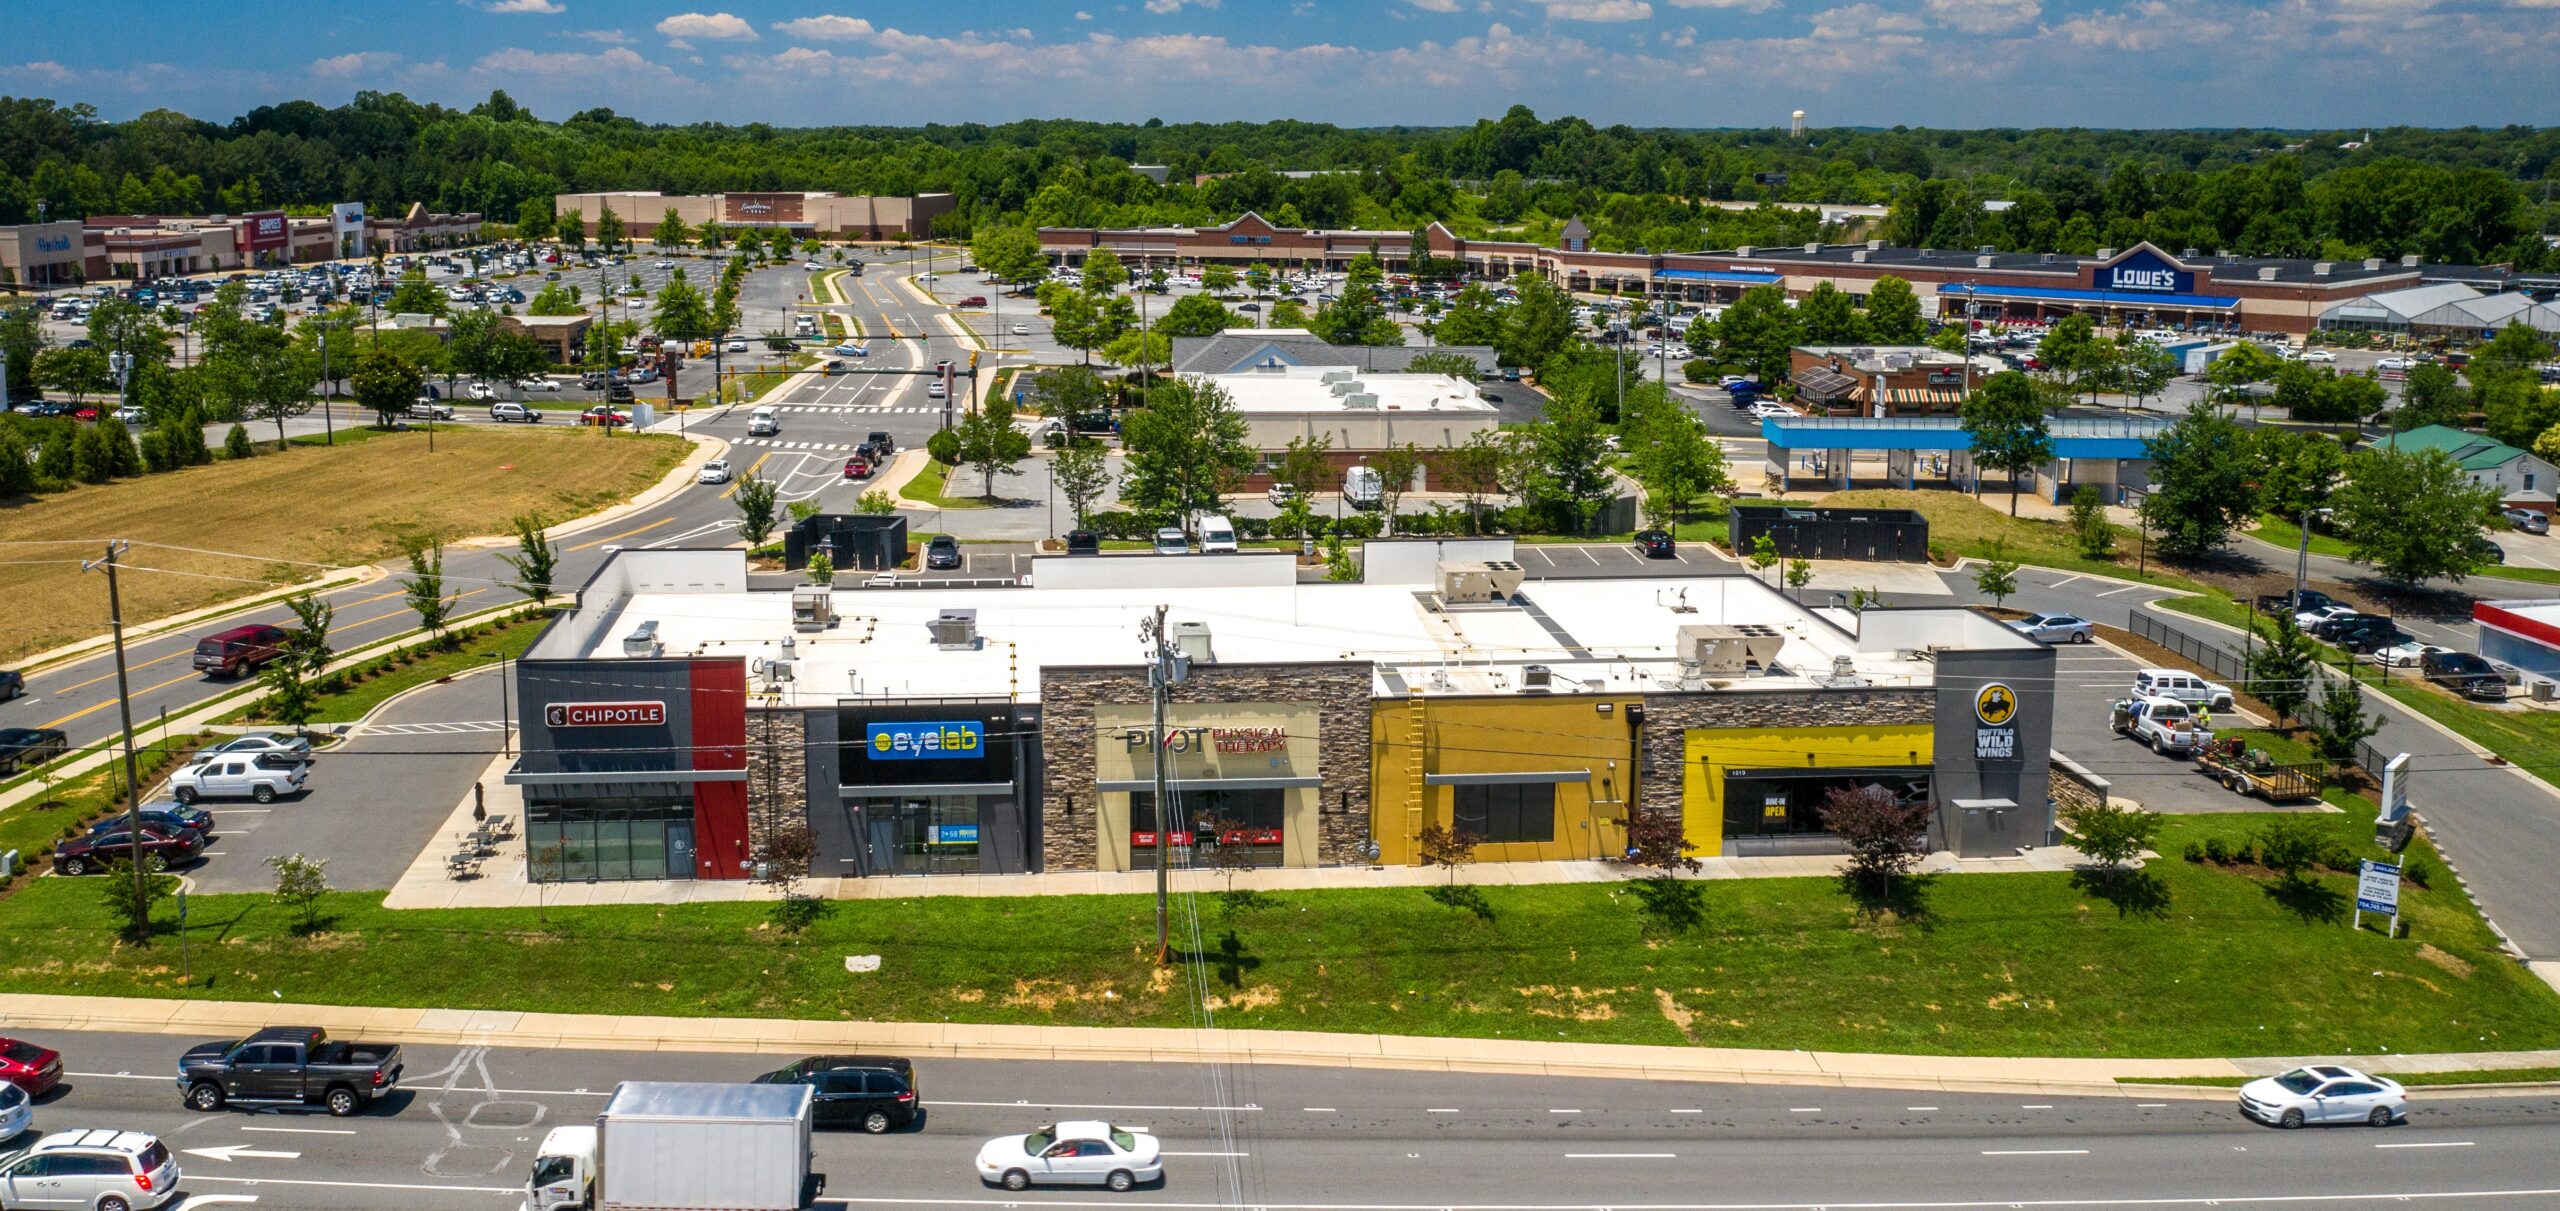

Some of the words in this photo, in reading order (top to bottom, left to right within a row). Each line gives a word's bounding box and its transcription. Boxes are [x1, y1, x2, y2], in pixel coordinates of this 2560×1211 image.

[2113, 267, 2175, 287] LOWE'S
[572, 709, 660, 722] CHIPOTLE
[1212, 726, 1288, 740] PHYSICAL
[1977, 728, 2014, 736] BUFFALO
[893, 725, 978, 757] eyelab
[1215, 739, 1286, 754] THERAPY
[1977, 735, 2014, 748] WILD
[1976, 747, 2013, 758] WINGS
[1765, 806, 1785, 817] OPEN
